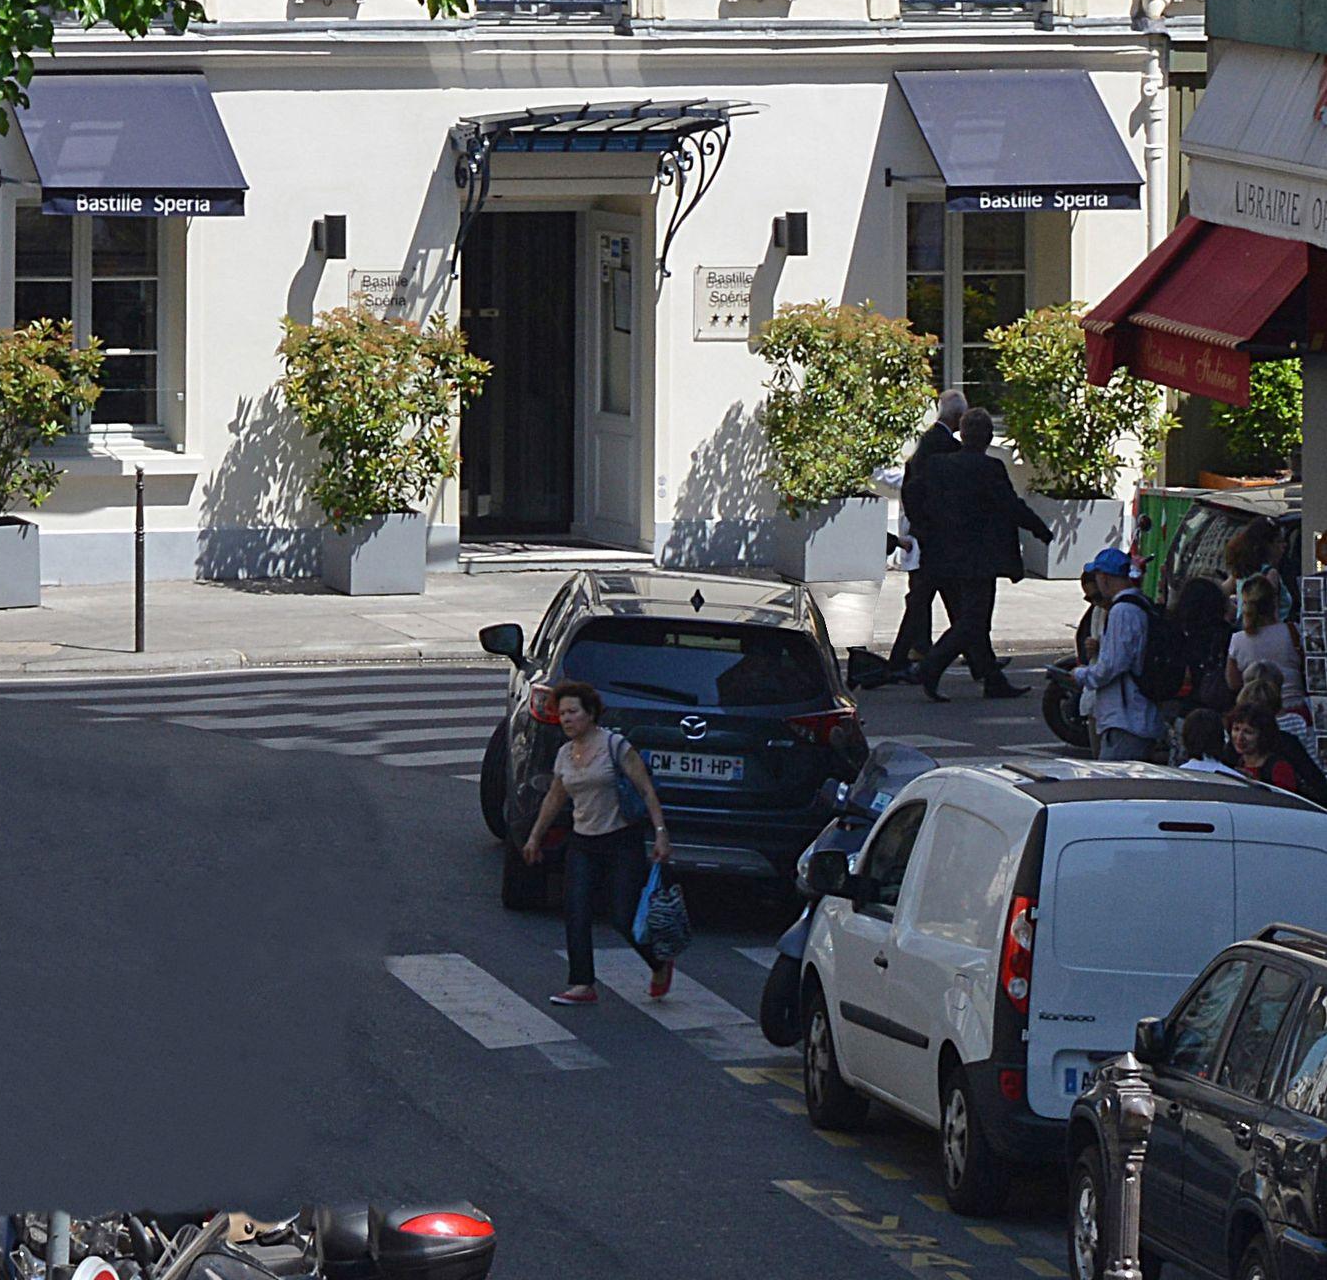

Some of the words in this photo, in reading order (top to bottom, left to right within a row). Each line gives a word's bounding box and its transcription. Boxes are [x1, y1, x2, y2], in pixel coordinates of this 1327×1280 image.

[76, 193, 143, 212] Bastille
[153, 194, 211, 216] Speria
[979, 191, 1043, 209] Bastille
[1053, 190, 1109, 211] Speria
[1235, 180, 1301, 227] LIBRAIRIE
[362, 274, 409, 288] Bastille
[707, 271, 754, 285] Bastille
